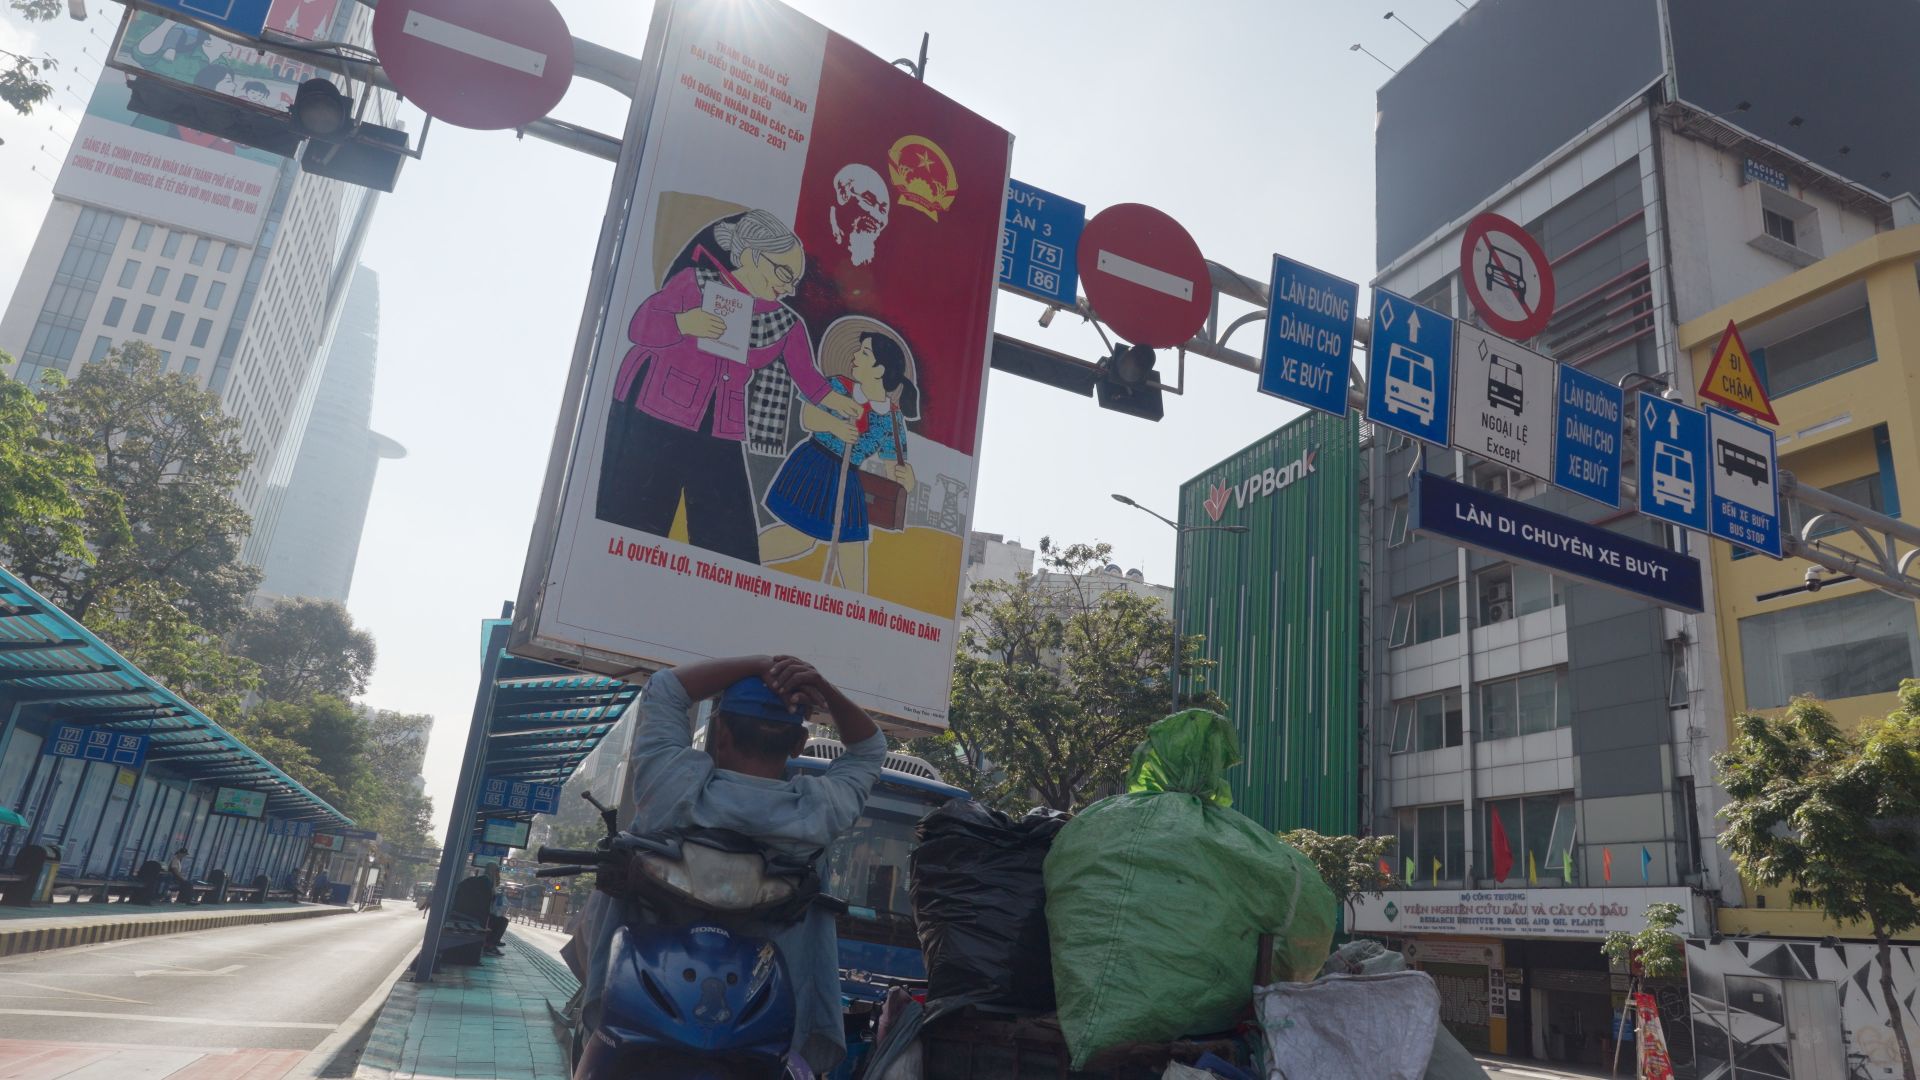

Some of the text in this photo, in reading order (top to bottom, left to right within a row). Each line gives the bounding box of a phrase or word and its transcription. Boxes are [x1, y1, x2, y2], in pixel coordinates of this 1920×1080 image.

[716, 40, 790, 86] THAM GIA BẦU CỬ
[690, 44, 807, 113] ĐẠI BIỂU QUỐC HỘI KHÓA XVI
[680, 73, 804, 143] HỘI ĐỒNG NHÂN DÂN CÁC CẤP
[722, 78, 772, 111] VÀ ĐẠI BIỂU
[694, 97, 724, 120] NHIỆM
[725, 112, 738, 126] KỲ
[766, 133, 787, 151] 2031
[1747, 159, 1785, 181] PACIFIC
[1007, 187, 1045, 211] BUÝT
[1006, 208, 1052, 237] ÀN 3
[1036, 244, 1056, 263] 75
[1034, 270, 1054, 290] 86
[1280, 274, 1349, 322] LÀN ĐƯỜNG
[1279, 312, 1341, 357] DÀNH CHO
[1280, 355, 1333, 394] XE BUÝT
[1730, 353, 1741, 372] ĐI
[1564, 379, 1618, 422] LÀN ĐƯỜNG
[1722, 375, 1753, 402] CHẬM
[1481, 412, 1528, 446] NGOẠI LỆ
[1566, 415, 1614, 455] DÀNH CHO
[1486, 437, 1520, 463] Except
[1234, 448, 1317, 509] VPBank
[1568, 454, 1608, 487] XE BUÝT
[1722, 501, 1770, 531] BẾN XE BUÝT
[1455, 503, 1668, 582] LÀN DI CHUYỂN XE BUÝT
[1729, 522, 1765, 545] BUS STOP
[608, 536, 624, 556] LÀ
[627, 543, 669, 568] QUYỀN
[670, 554, 691, 577] LỢI,
[695, 561, 733, 586] TRÁCH
[735, 572, 771, 597] NHIỆM
[774, 584, 812, 608] THIÊNG
[814, 594, 844, 615] LIÊNG
[846, 600, 866, 621] CỦA
[890, 615, 916, 635] CÔNG
[918, 622, 941, 642] DÂN!
[64, 728, 137, 748] 171 19 56
[513, 784, 528, 796] 102
[1404, 903, 1429, 916] VIỆN
[1431, 903, 1473, 915] NGHIÊN
[1475, 902, 1500, 915] CỨU
[1503, 902, 1527, 915] DẦU
[1531, 903, 1546, 916] VÀ
[1549, 903, 1573, 916] CÂY
[1577, 903, 1597, 916] CÓ
[1600, 902, 1628, 917] DẦU
[1472, 892, 1492, 901] CÔNG
[690, 926, 730, 938] HONDA
[1420, 916, 1455, 924] RESEARCH
[1497, 917, 1512, 925] FOR
[1515, 917, 1529, 925] OIL
[1533, 918, 1549, 926] AND
[1553, 918, 1568, 926] OIL
[1571, 918, 1605, 926] PLANTS
